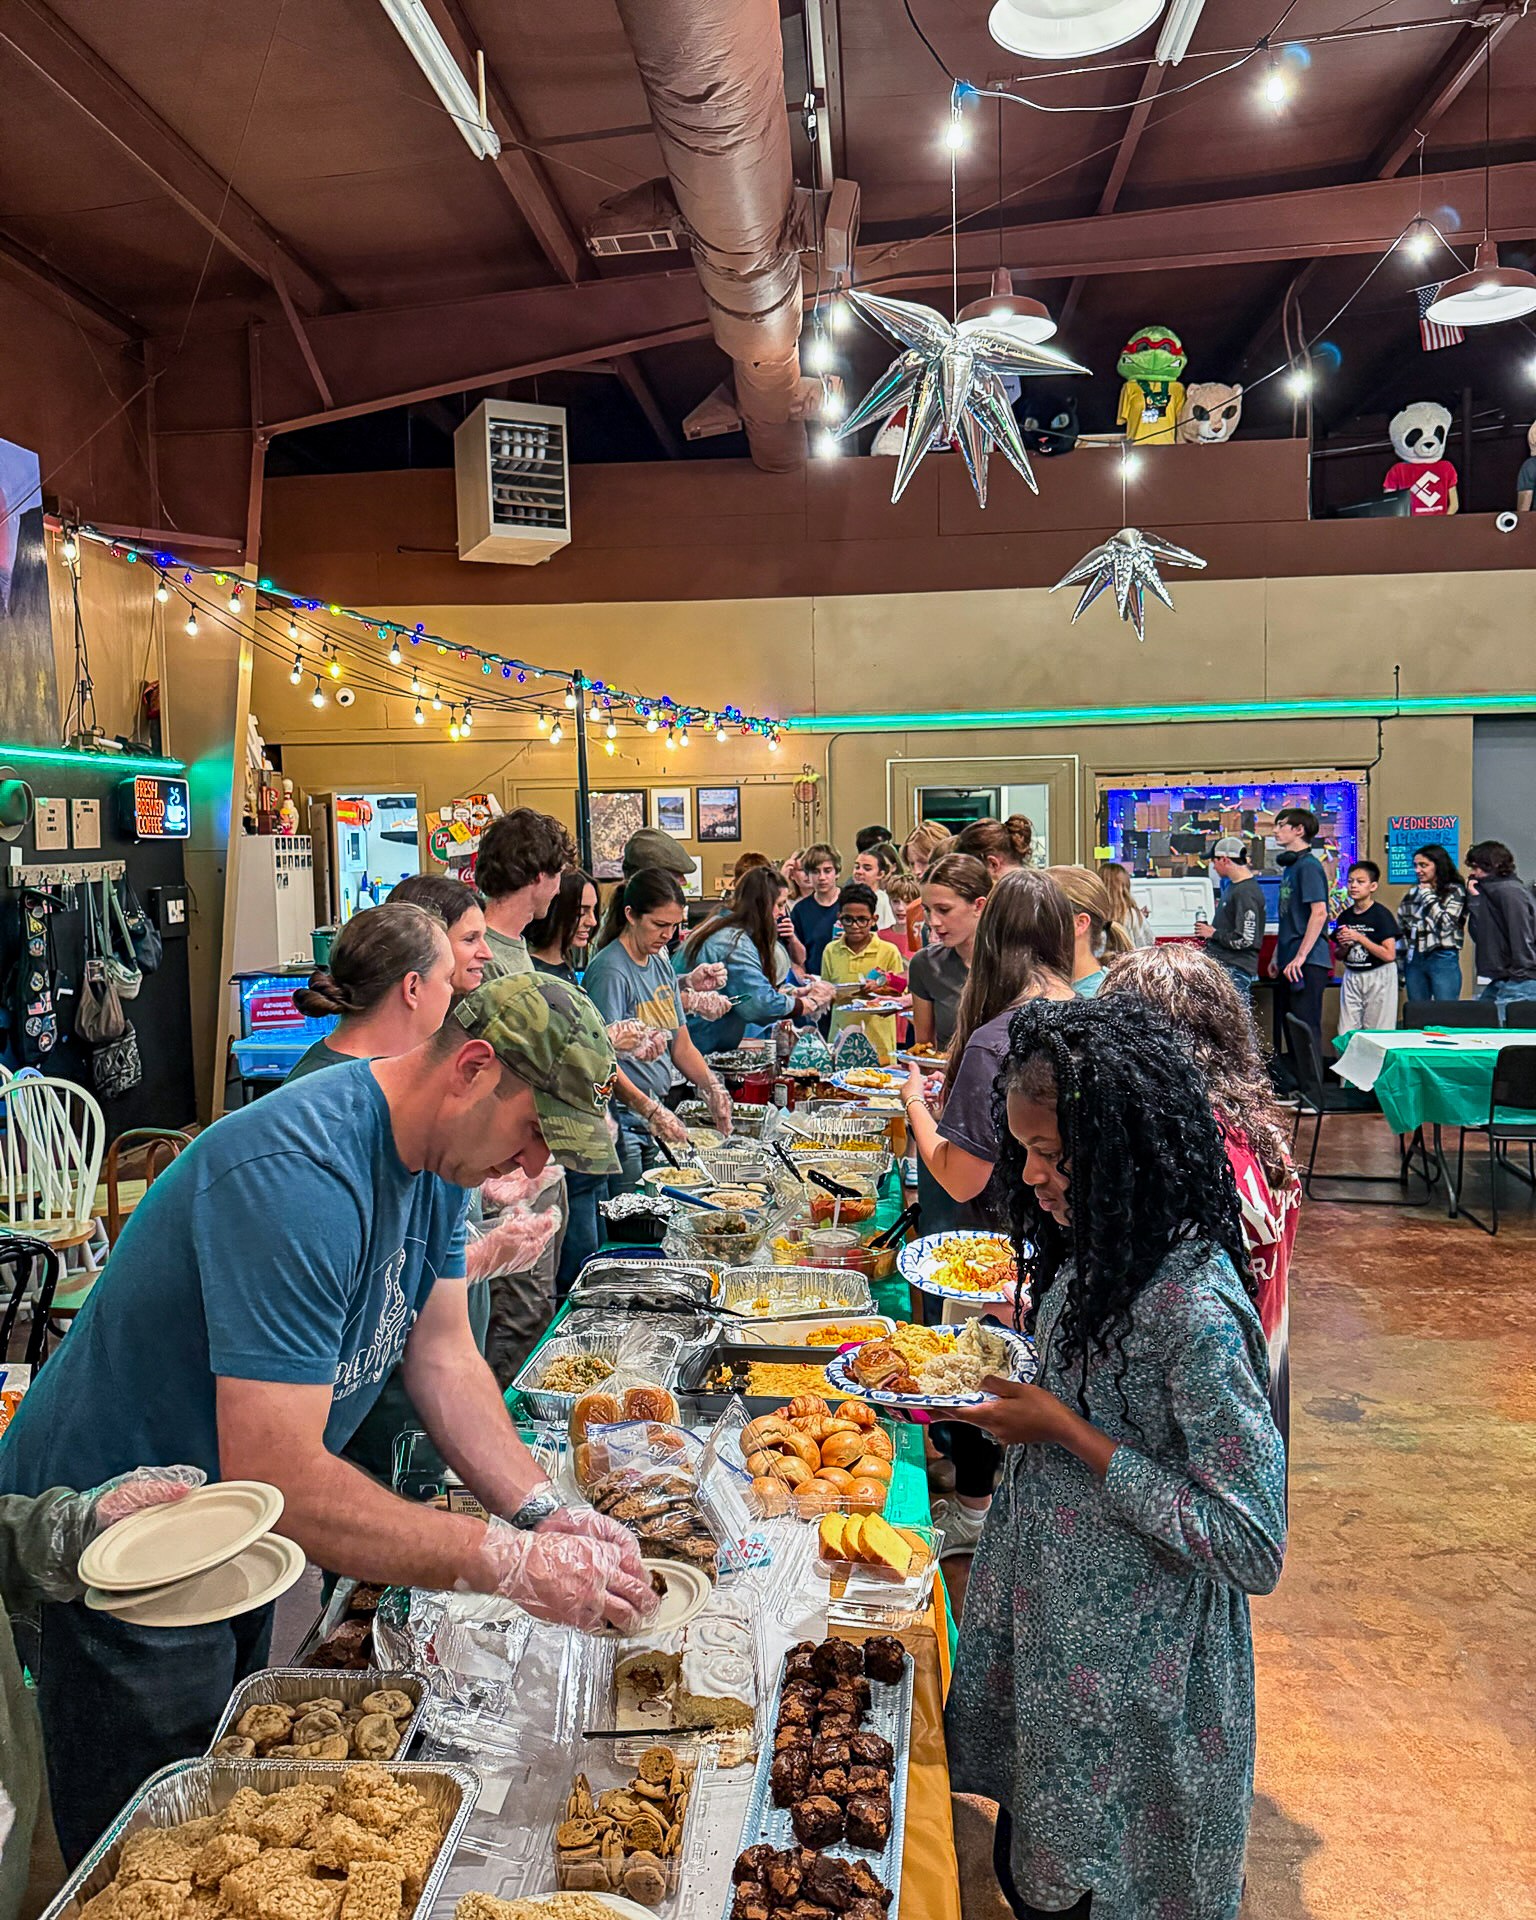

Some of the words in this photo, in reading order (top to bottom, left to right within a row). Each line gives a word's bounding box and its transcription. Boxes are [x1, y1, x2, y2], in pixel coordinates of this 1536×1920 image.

[136, 780, 158, 798] FRESH
[136, 798, 165, 816] BREWED
[137, 816, 163, 833] COFFEE
[1391, 816, 1456, 830] WEDNESDAY
